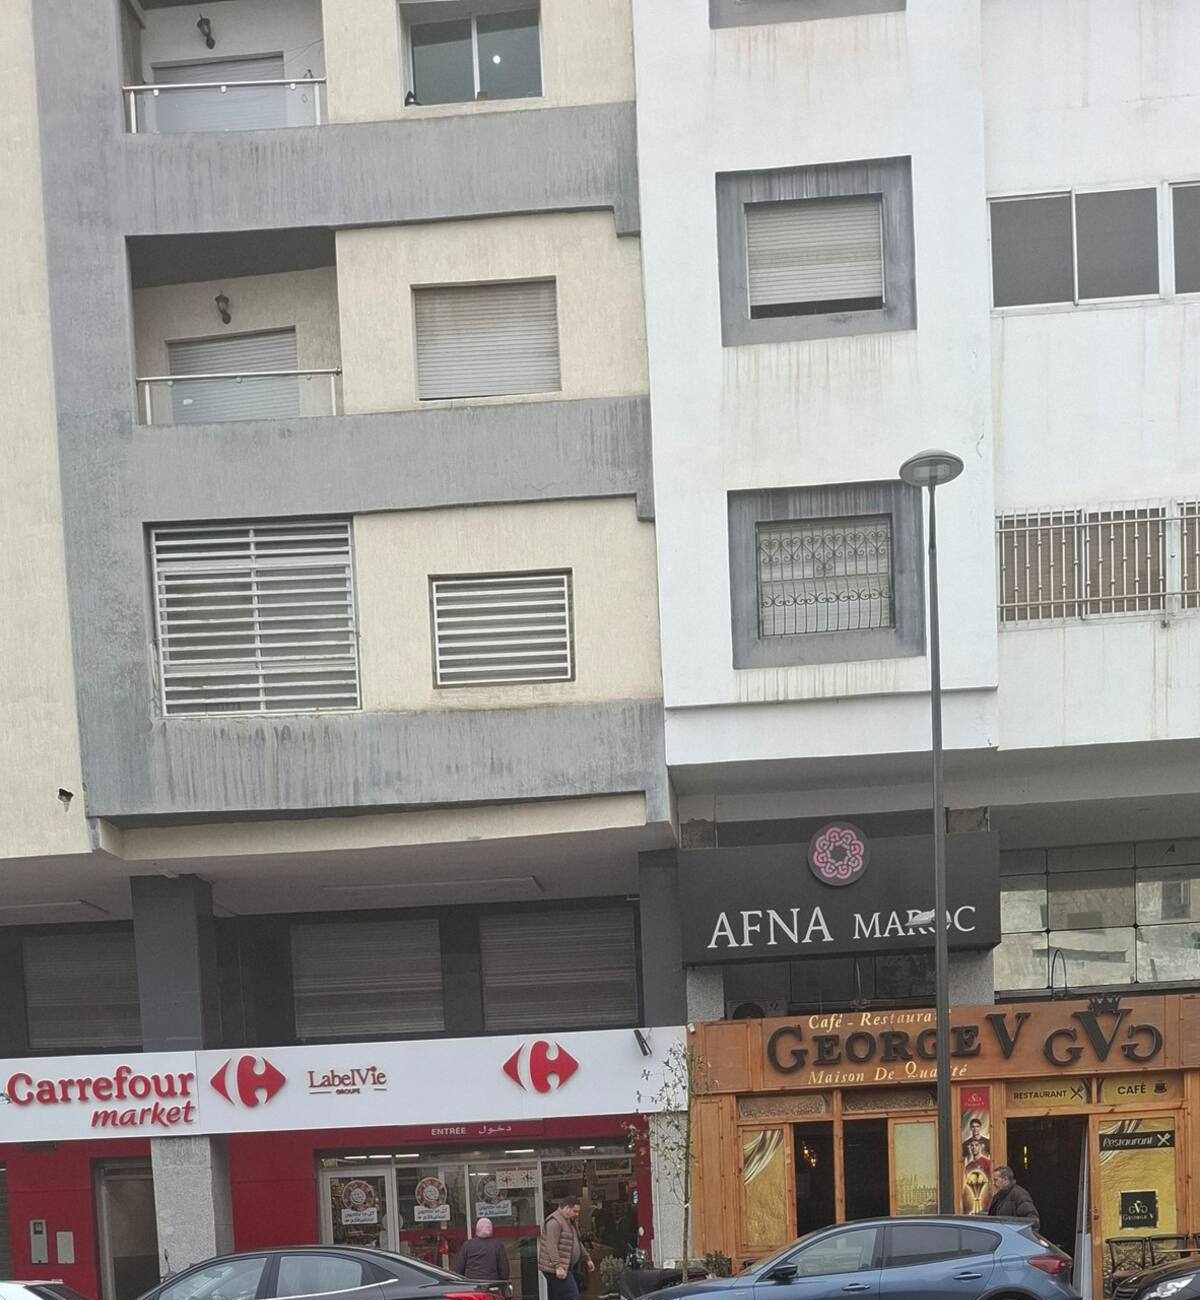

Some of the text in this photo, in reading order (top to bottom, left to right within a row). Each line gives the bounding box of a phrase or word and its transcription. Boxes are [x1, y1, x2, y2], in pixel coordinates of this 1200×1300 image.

[707, 906, 834, 948] AFNA
[808, 1013, 842, 1032] Café
[860, 1008, 951, 1026] Restaura
[767, 1012, 1031, 1074] GEORGE V
[307, 1066, 387, 1088] LabelVie
[808, 1061, 968, 1085] Maison De Quaté
[6, 1065, 195, 1106] Carrefour
[1013, 1089, 1067, 1100] RESTAURANT
[1117, 1083, 1146, 1095] CAFÉ
[91, 1100, 195, 1127] market
[479, 1125, 512, 1134] دخول
[1103, 1137, 1153, 1147] Restaurant
